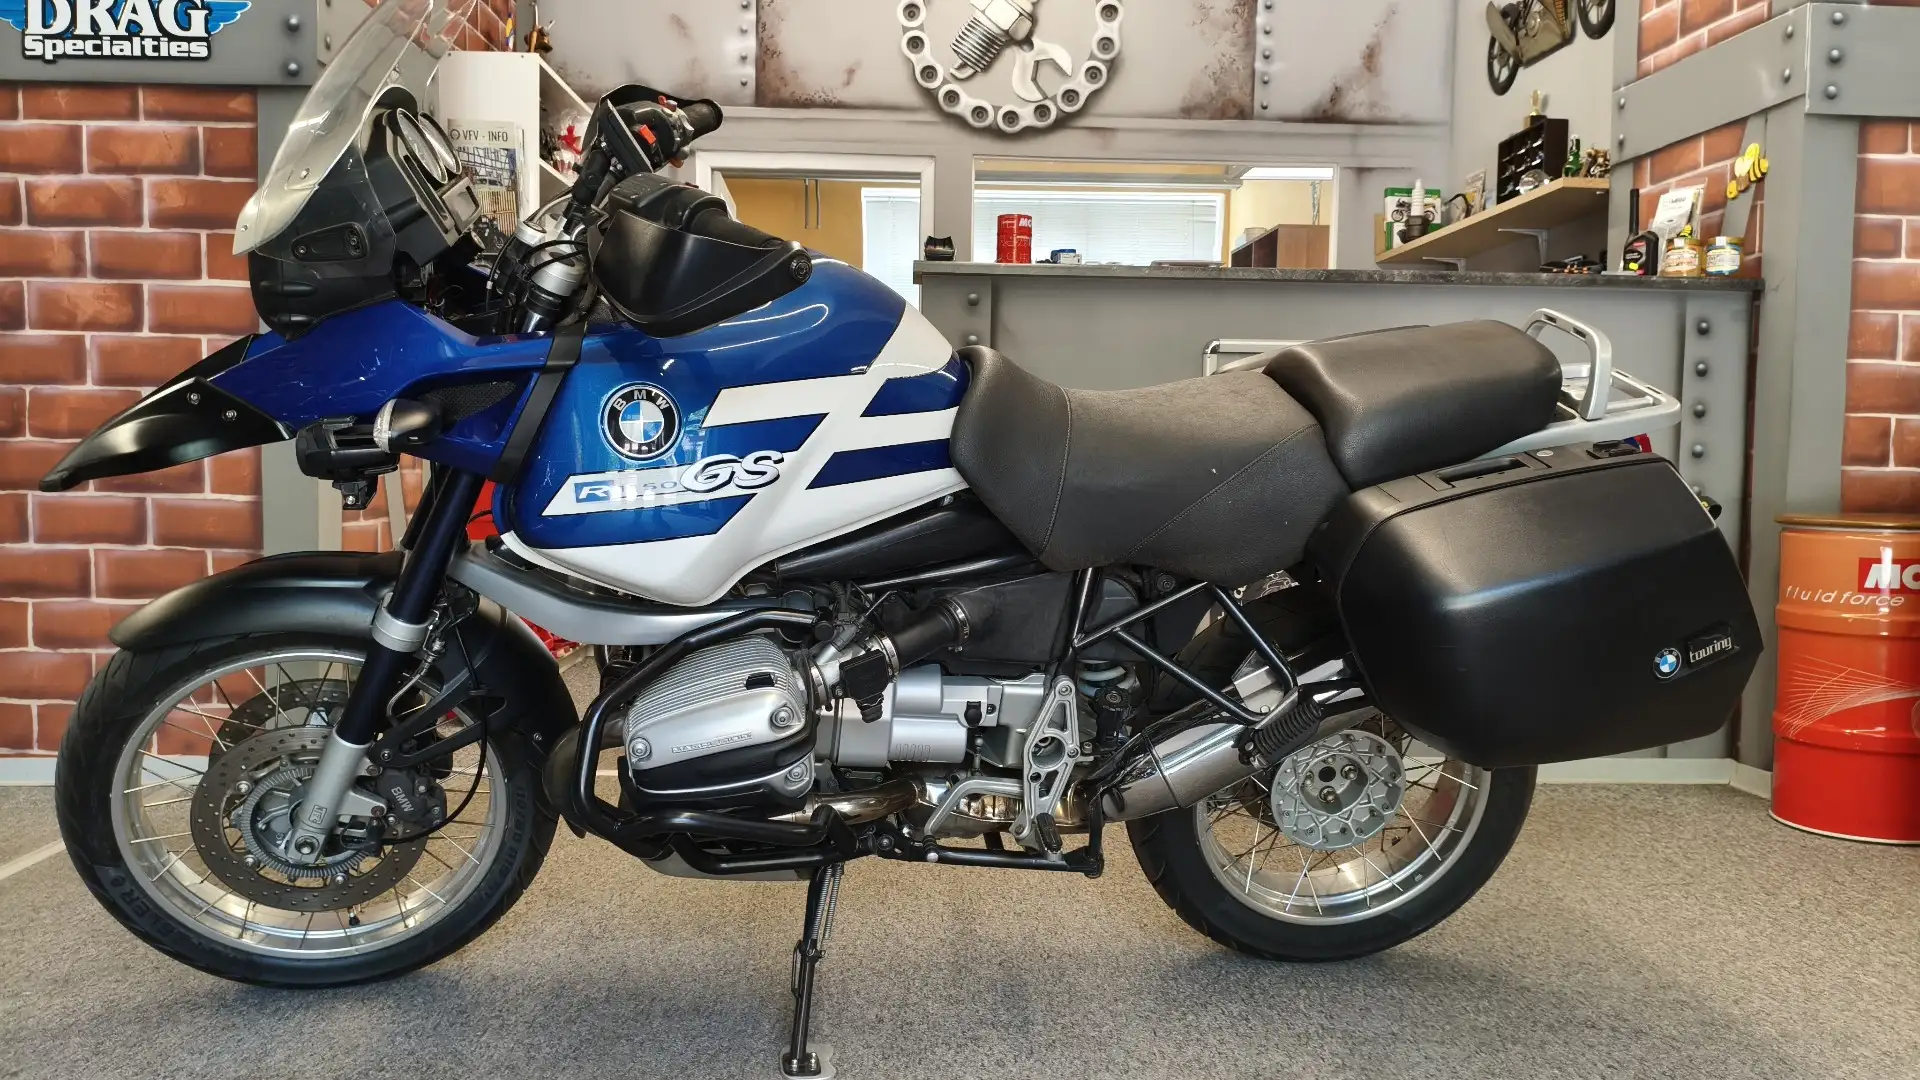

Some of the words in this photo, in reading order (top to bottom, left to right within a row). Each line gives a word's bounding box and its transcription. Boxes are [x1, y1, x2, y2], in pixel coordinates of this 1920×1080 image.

[25, 0, 210, 37] DRAG
[24, 36, 209, 60] Specialties
[462, 129, 479, 141] VFV
[488, 130, 509, 142] INFO
[612, 389, 670, 411] BMW
[680, 450, 784, 493] GS
[1785, 585, 1838, 604] fluid
[1839, 590, 1905, 607] force
[1689, 636, 1733, 663] touring
[391, 786, 414, 812] BMW
